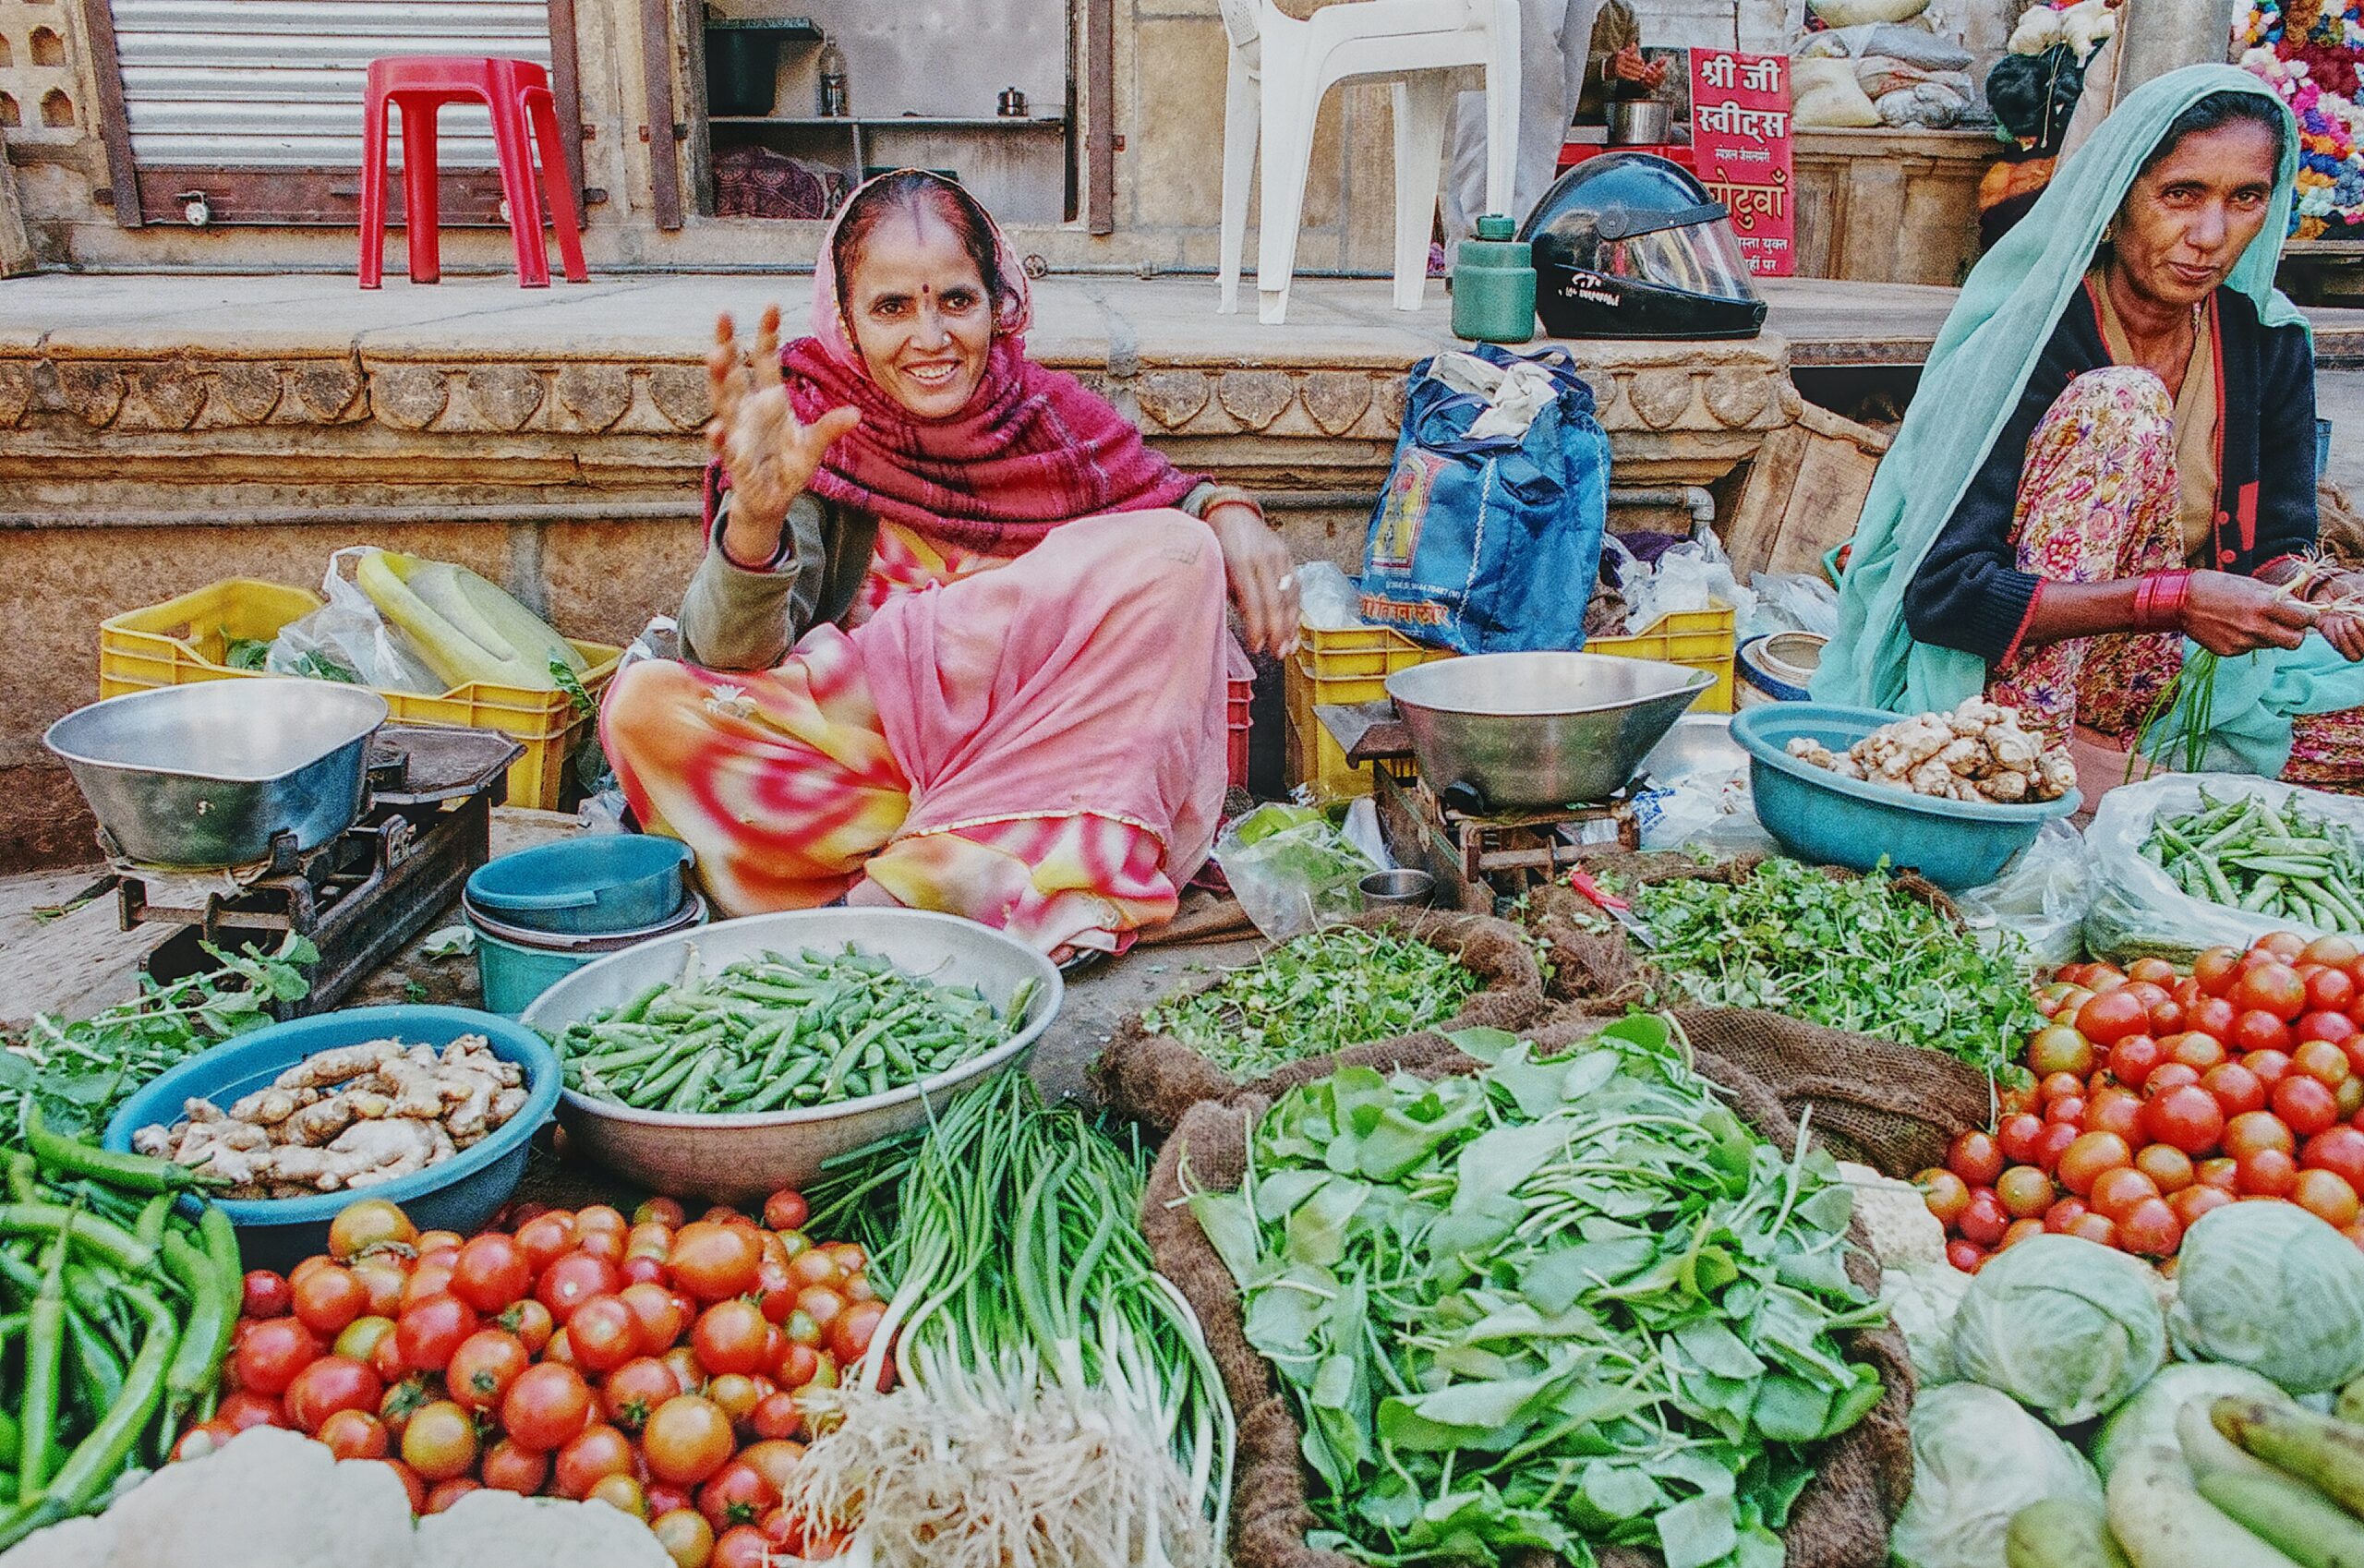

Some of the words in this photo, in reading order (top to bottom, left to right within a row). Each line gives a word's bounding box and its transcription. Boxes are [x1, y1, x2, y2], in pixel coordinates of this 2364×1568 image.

[1701, 54, 1736, 90] श्री
[1739, 58, 1781, 93] जी
[1695, 101, 1789, 144] स्वीट्स
[1737, 236, 1760, 250] स्ता
[1761, 259, 1778, 271] पर
